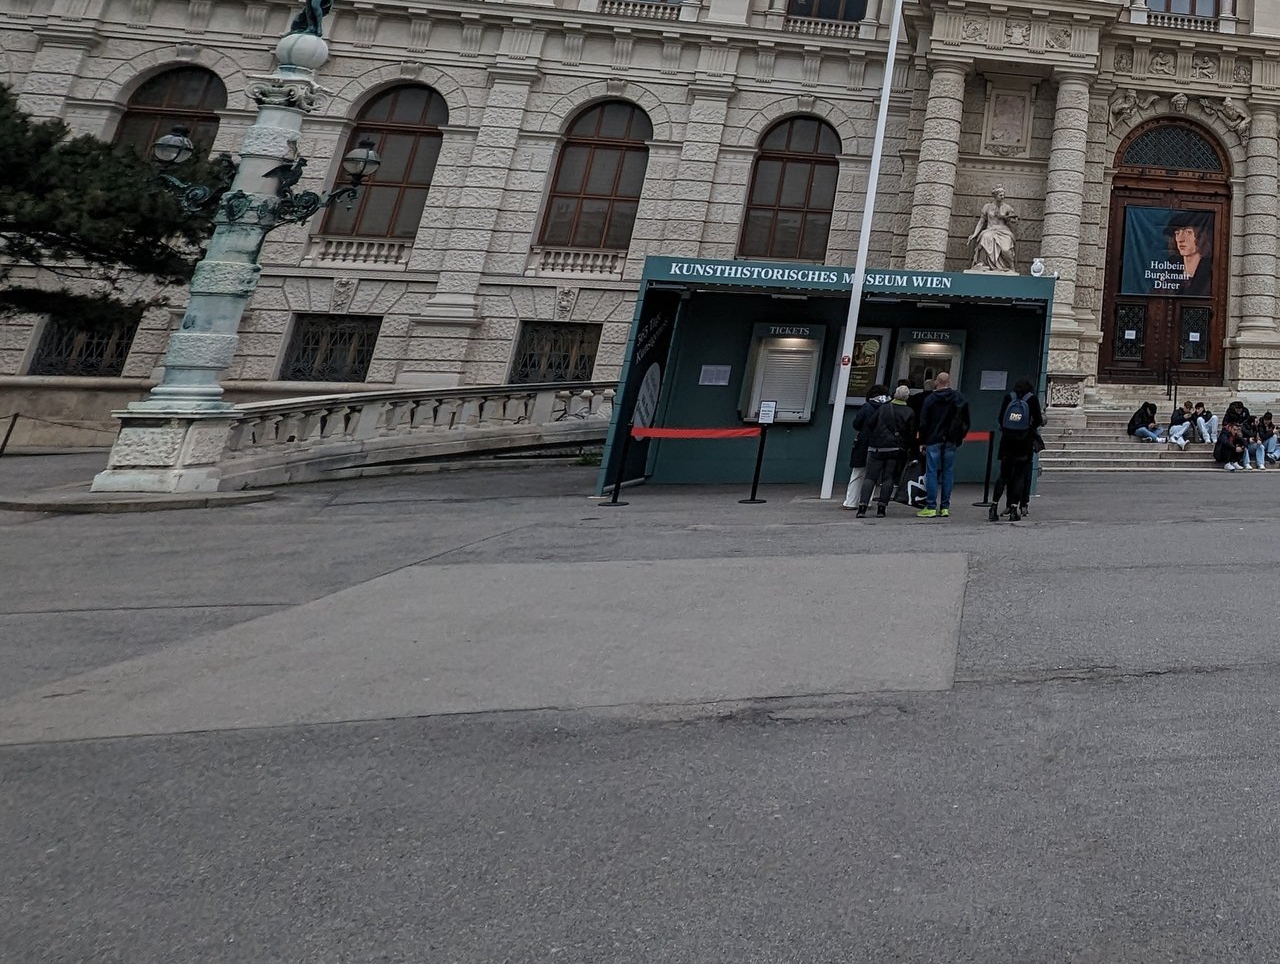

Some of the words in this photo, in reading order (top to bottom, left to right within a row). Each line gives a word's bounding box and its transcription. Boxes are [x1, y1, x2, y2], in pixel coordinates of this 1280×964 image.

[1150, 260, 1185, 270] Holbein
[669, 262, 837, 284] KUNSTHISTORISCHES
[841, 272, 908, 286] MSEUM
[912, 276, 952, 289] WIEN
[1144, 269, 1190, 281] Burgkmair
[1153, 280, 1180, 289] Dürer
[769, 326, 810, 336] TICKETS
[911, 331, 951, 340] TICKETS
